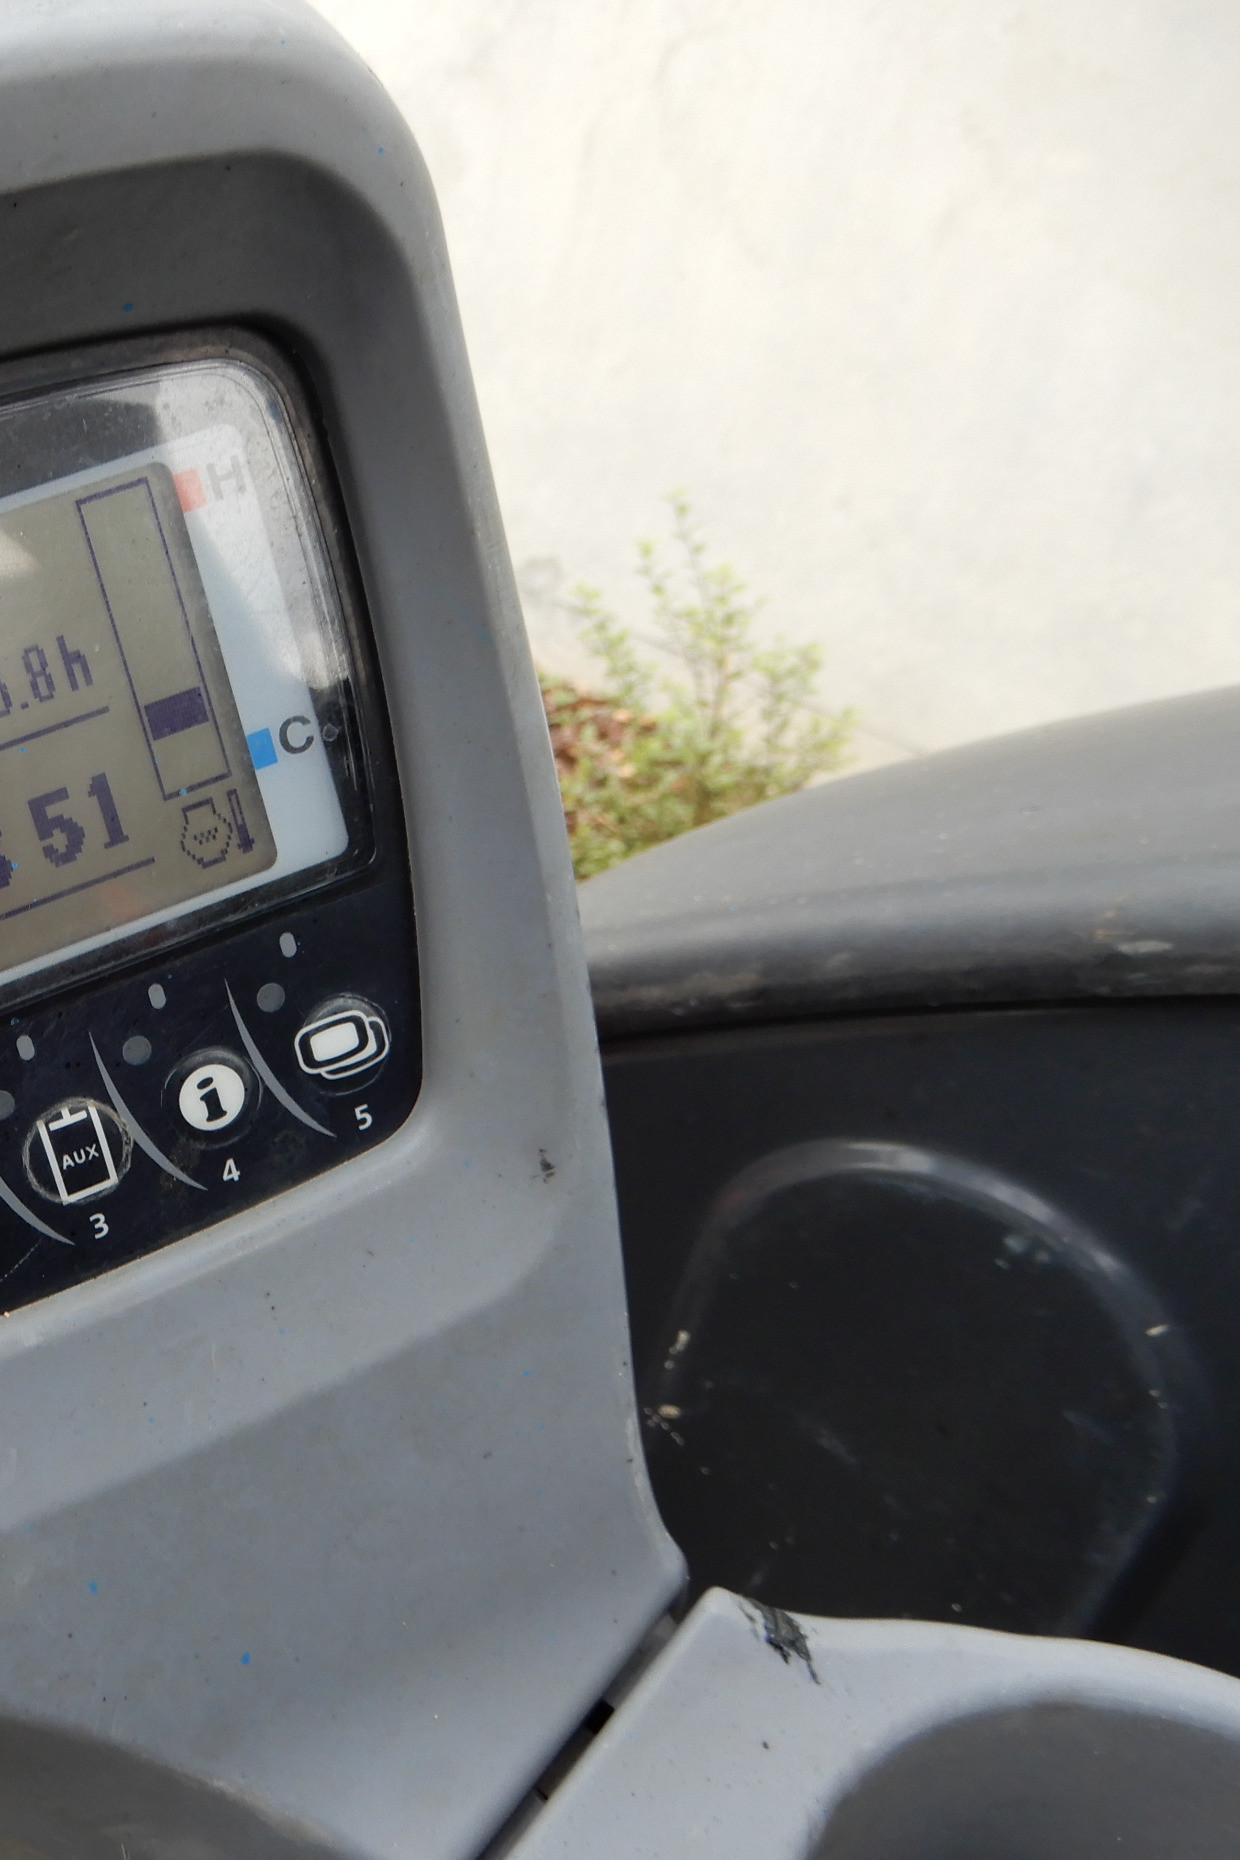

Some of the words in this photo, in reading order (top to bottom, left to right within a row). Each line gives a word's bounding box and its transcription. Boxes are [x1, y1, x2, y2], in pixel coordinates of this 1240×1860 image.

[278, 714, 315, 755] C
[354, 1103, 374, 1131] 5
[61, 1142, 100, 1171] AUX
[221, 1157, 241, 1183] 4
[88, 1212, 110, 1240] 3
